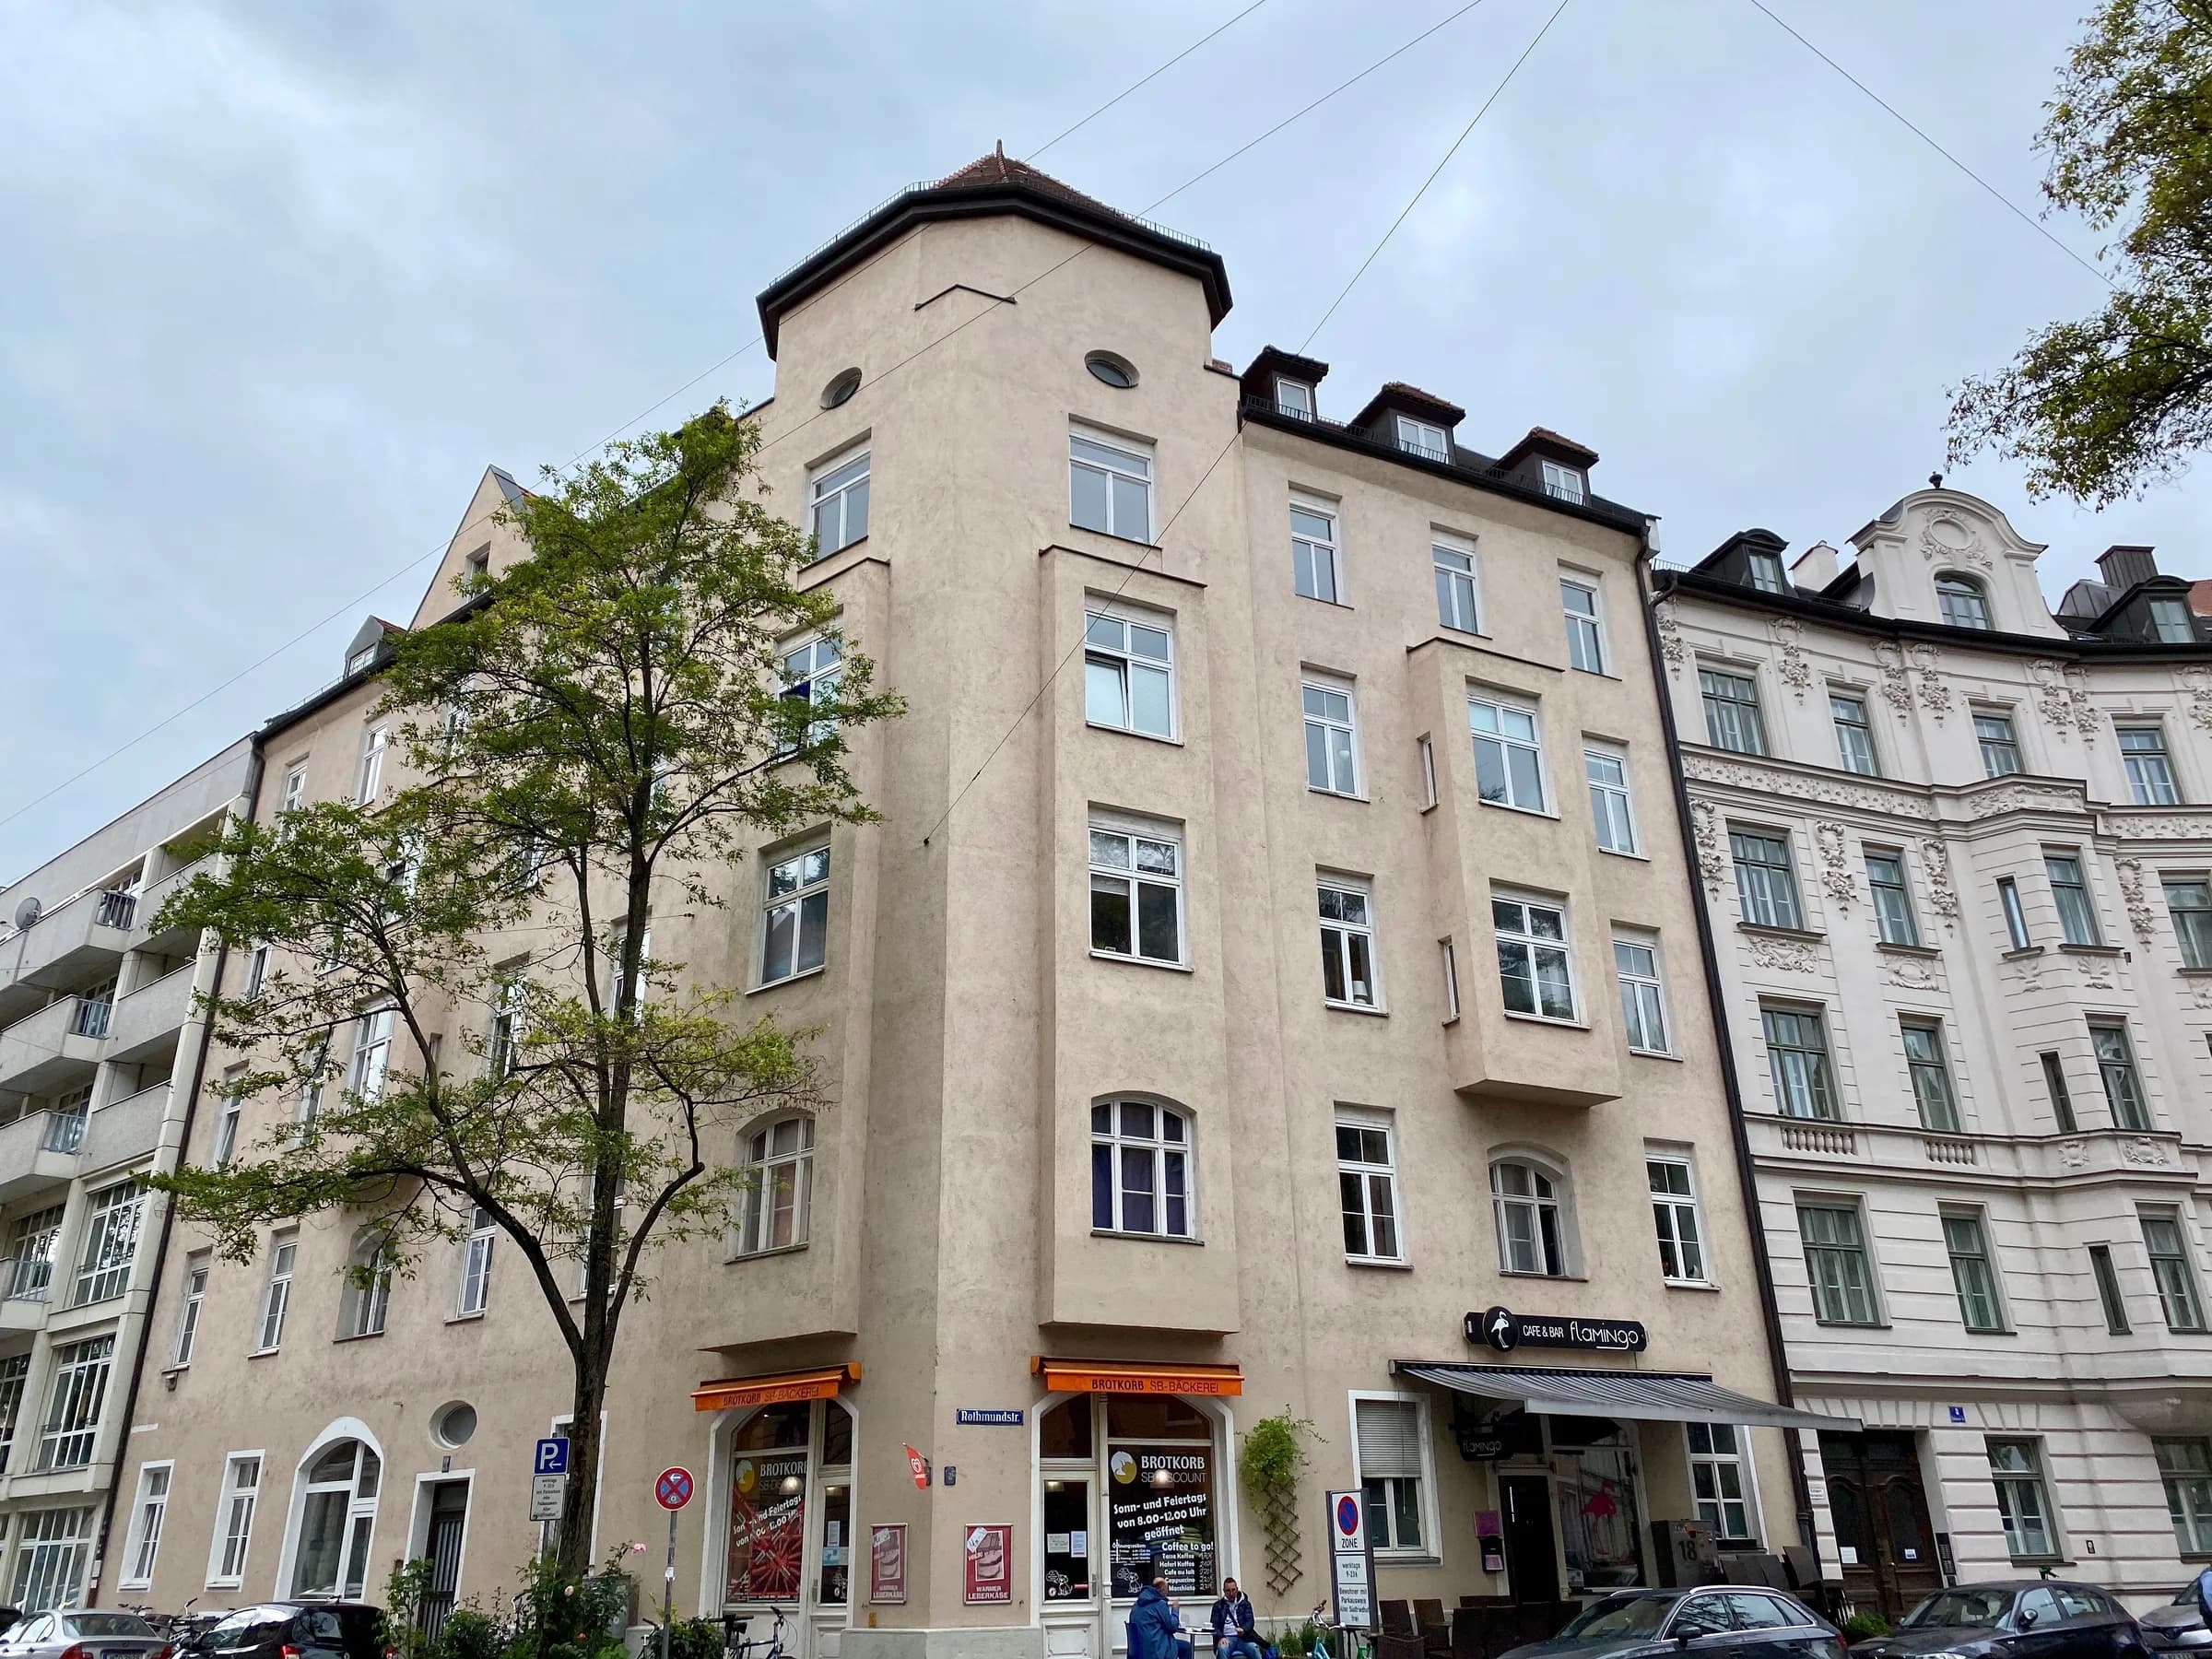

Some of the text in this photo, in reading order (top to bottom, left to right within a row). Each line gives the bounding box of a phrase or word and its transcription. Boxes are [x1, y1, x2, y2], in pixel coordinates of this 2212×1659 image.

[1523, 1324, 1541, 1337] CAFE
[1542, 1325, 1548, 1337] &
[1549, 1325, 1565, 1338] BAR
[1091, 1379, 1145, 1391] BROTKORB
[723, 1394, 761, 1406] BROTKORB
[961, 1410, 1020, 1423] Rothmundstr.
[539, 1442, 559, 1470] P
[1141, 1456, 1205, 1469] BROTKORB
[1113, 1493, 1206, 1514] Sonn- und Feiertags
[1117, 1506, 1207, 1528] von 8.00-12.00 Uhr
[1144, 1524, 1185, 1540] geöffnet
[1161, 1541, 1214, 1552] Coffee to go!
[1341, 1538, 1358, 1548] ZONE
[1677, 1540, 1698, 1560] 18
[968, 1591, 1009, 1600] LEBERKÄSE
